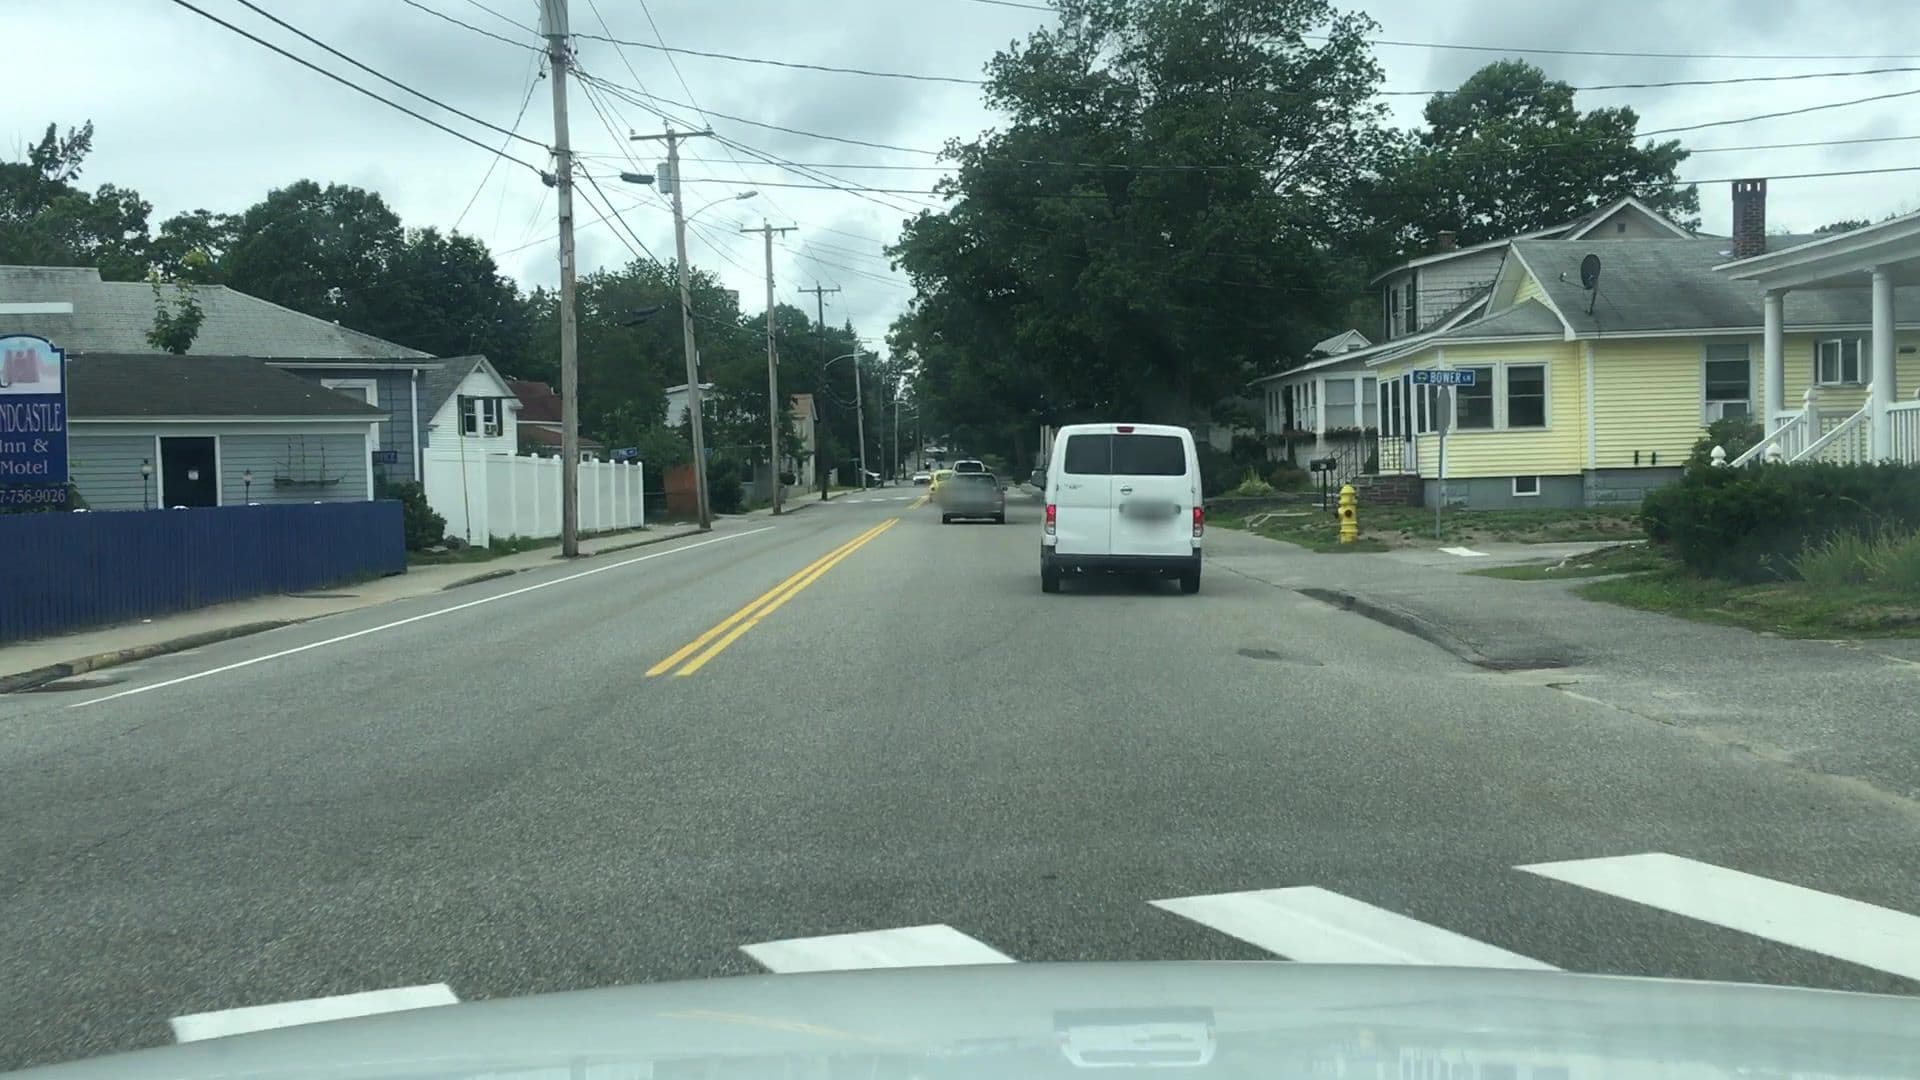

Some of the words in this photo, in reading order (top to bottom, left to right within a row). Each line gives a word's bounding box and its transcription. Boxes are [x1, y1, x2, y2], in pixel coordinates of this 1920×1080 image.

[1430, 371, 1461, 384] BOWER
[0, 439, 26, 453] Inn
[33, 438, 48, 453] &
[0, 460, 48, 475] Motel
